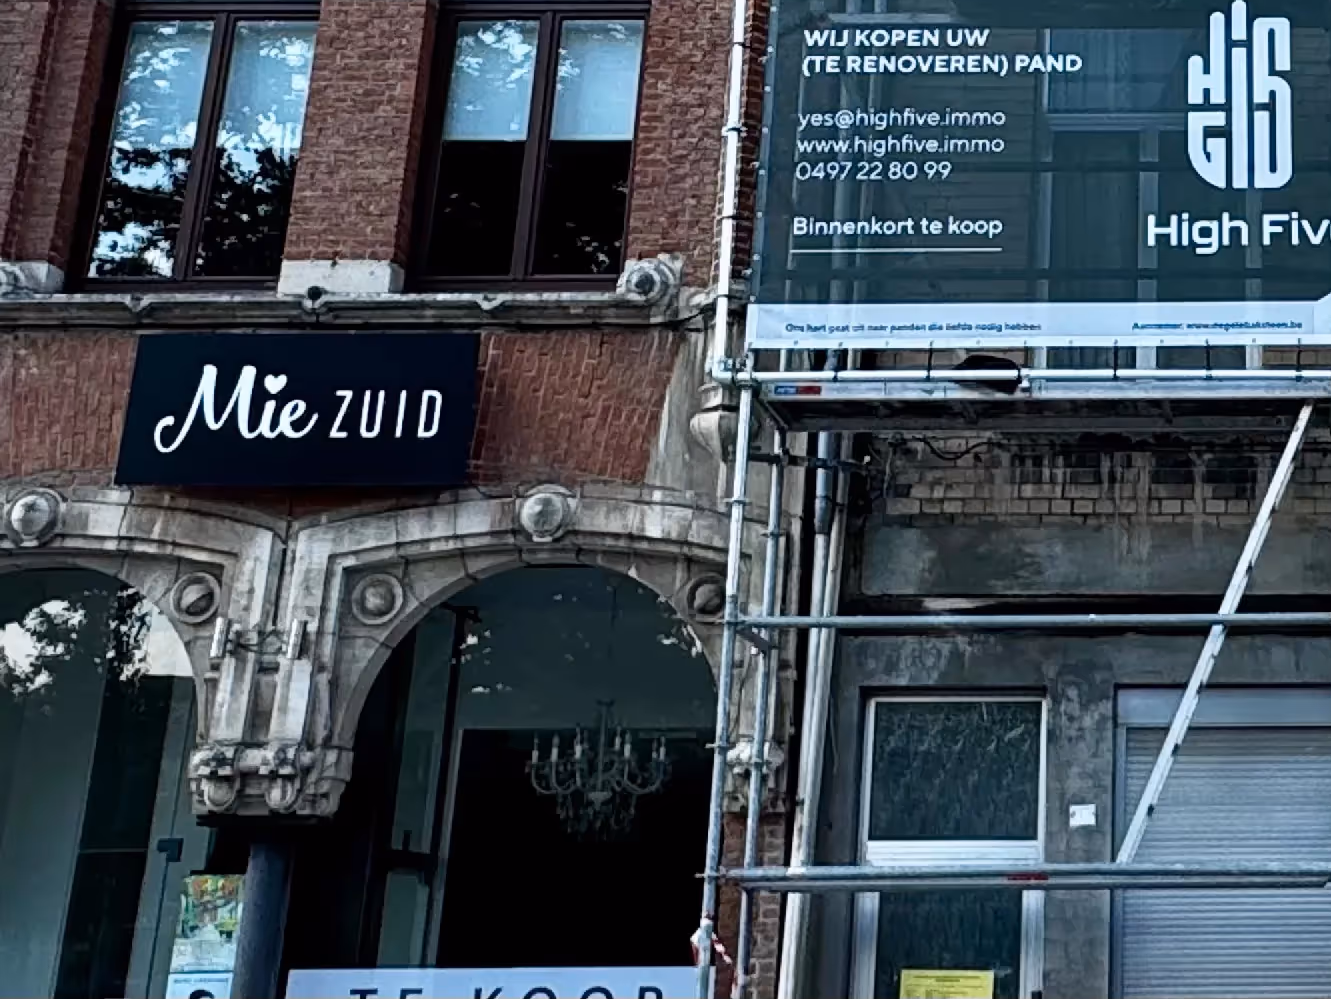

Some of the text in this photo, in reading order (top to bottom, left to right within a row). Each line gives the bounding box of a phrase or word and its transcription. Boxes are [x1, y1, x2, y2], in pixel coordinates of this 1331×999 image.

[804, 28, 991, 47] WIJ KOPEN UW
[801, 54, 1083, 77] (TE RENOVEREN) PAND
[799, 108, 1007, 131] yes@highfive.immo
[796, 133, 1005, 157] www.highfive.immo
[795, 161, 953, 181] 0497 22 80 99
[792, 215, 1004, 239] Binnenkort te koop
[1147, 211, 1250, 255] High
[153, 363, 443, 453] Mie ZUID
